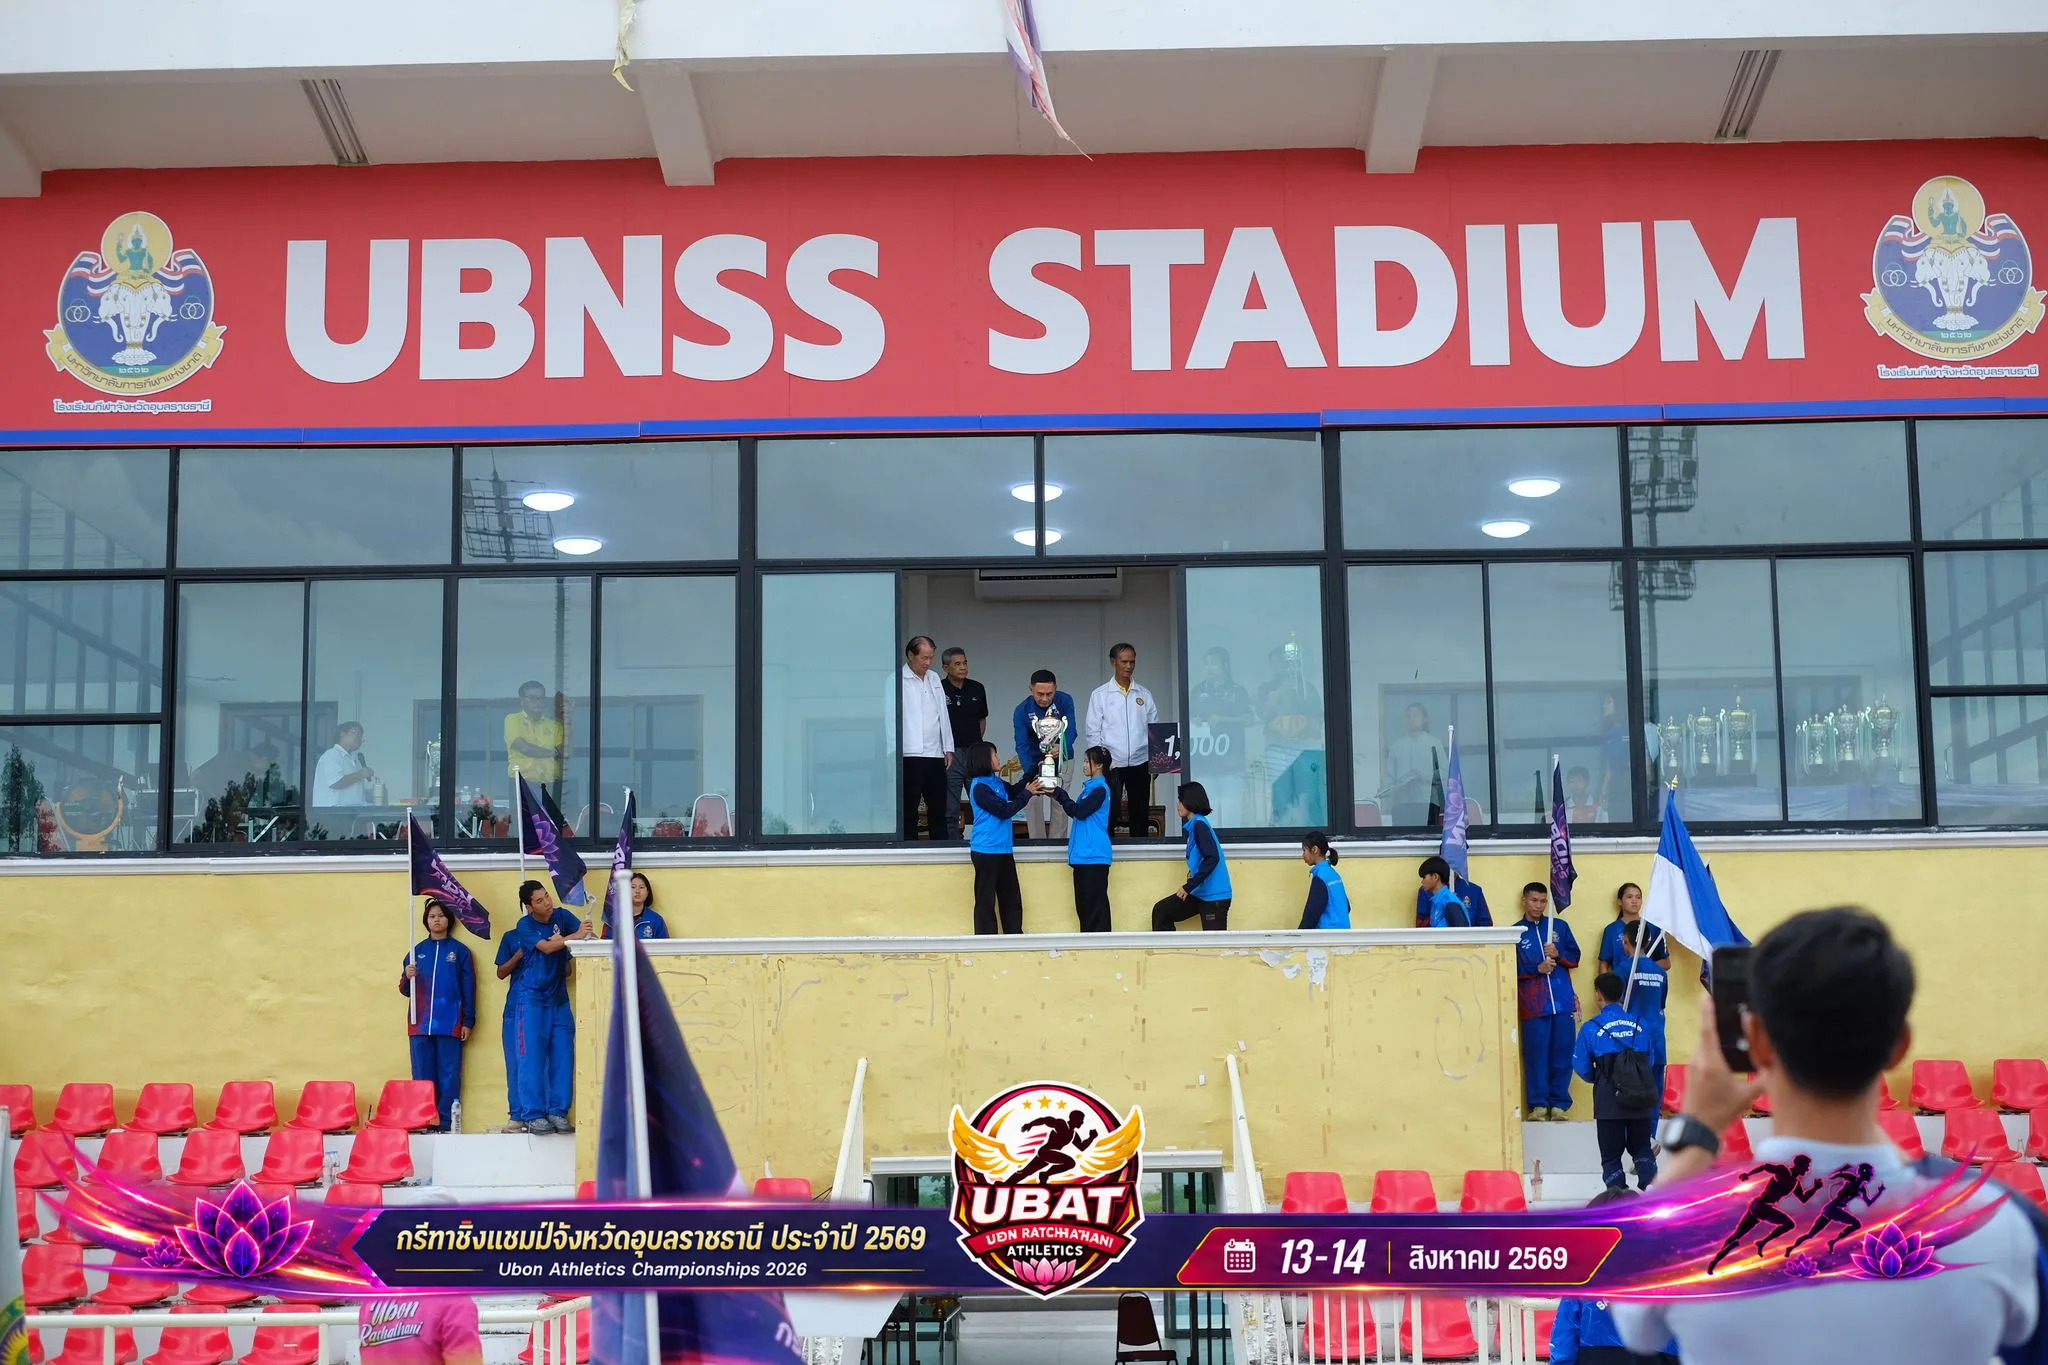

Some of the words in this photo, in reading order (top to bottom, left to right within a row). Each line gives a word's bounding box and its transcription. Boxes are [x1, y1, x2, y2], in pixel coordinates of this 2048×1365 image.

[285, 233, 885, 383] UBNSS
[989, 217, 1806, 375] STADIUM
[1879, 366, 2038, 379] โรงเรียนกีฬาจังหวัดอุบลราชธานี
[54, 400, 210, 413] โรงเรียนกีฬาจังหวัดอุบลราชธานี
[370, 1300, 420, 1325] Ubon
